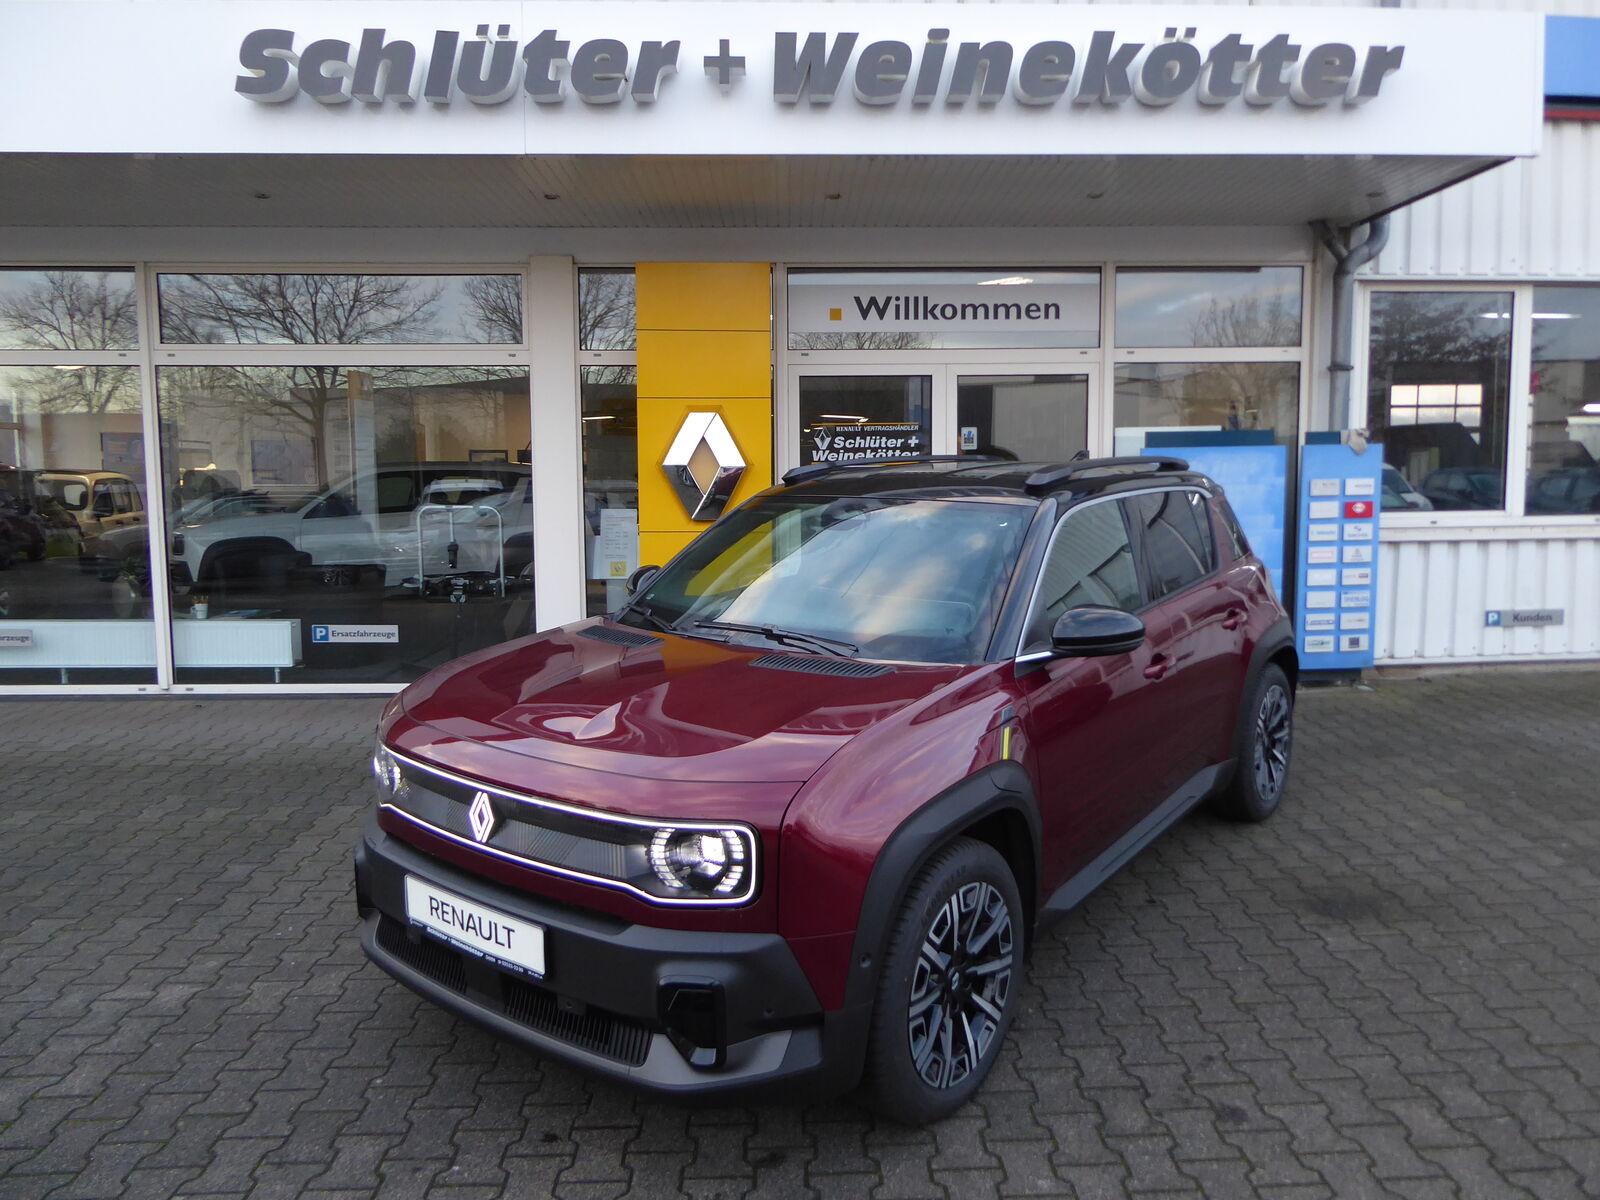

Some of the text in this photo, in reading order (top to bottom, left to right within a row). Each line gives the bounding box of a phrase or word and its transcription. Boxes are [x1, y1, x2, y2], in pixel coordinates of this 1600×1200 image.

[235, 24, 1405, 106] Schlüter + Weinekötter
[853, 295, 1060, 321] Willkommen
[833, 436, 919, 449] Schlüter +
[1512, 612, 1552, 623] Kunden
[315, 627, 396, 639] P Ersatzfahrzeuge
[428, 895, 516, 949] RENAULT
